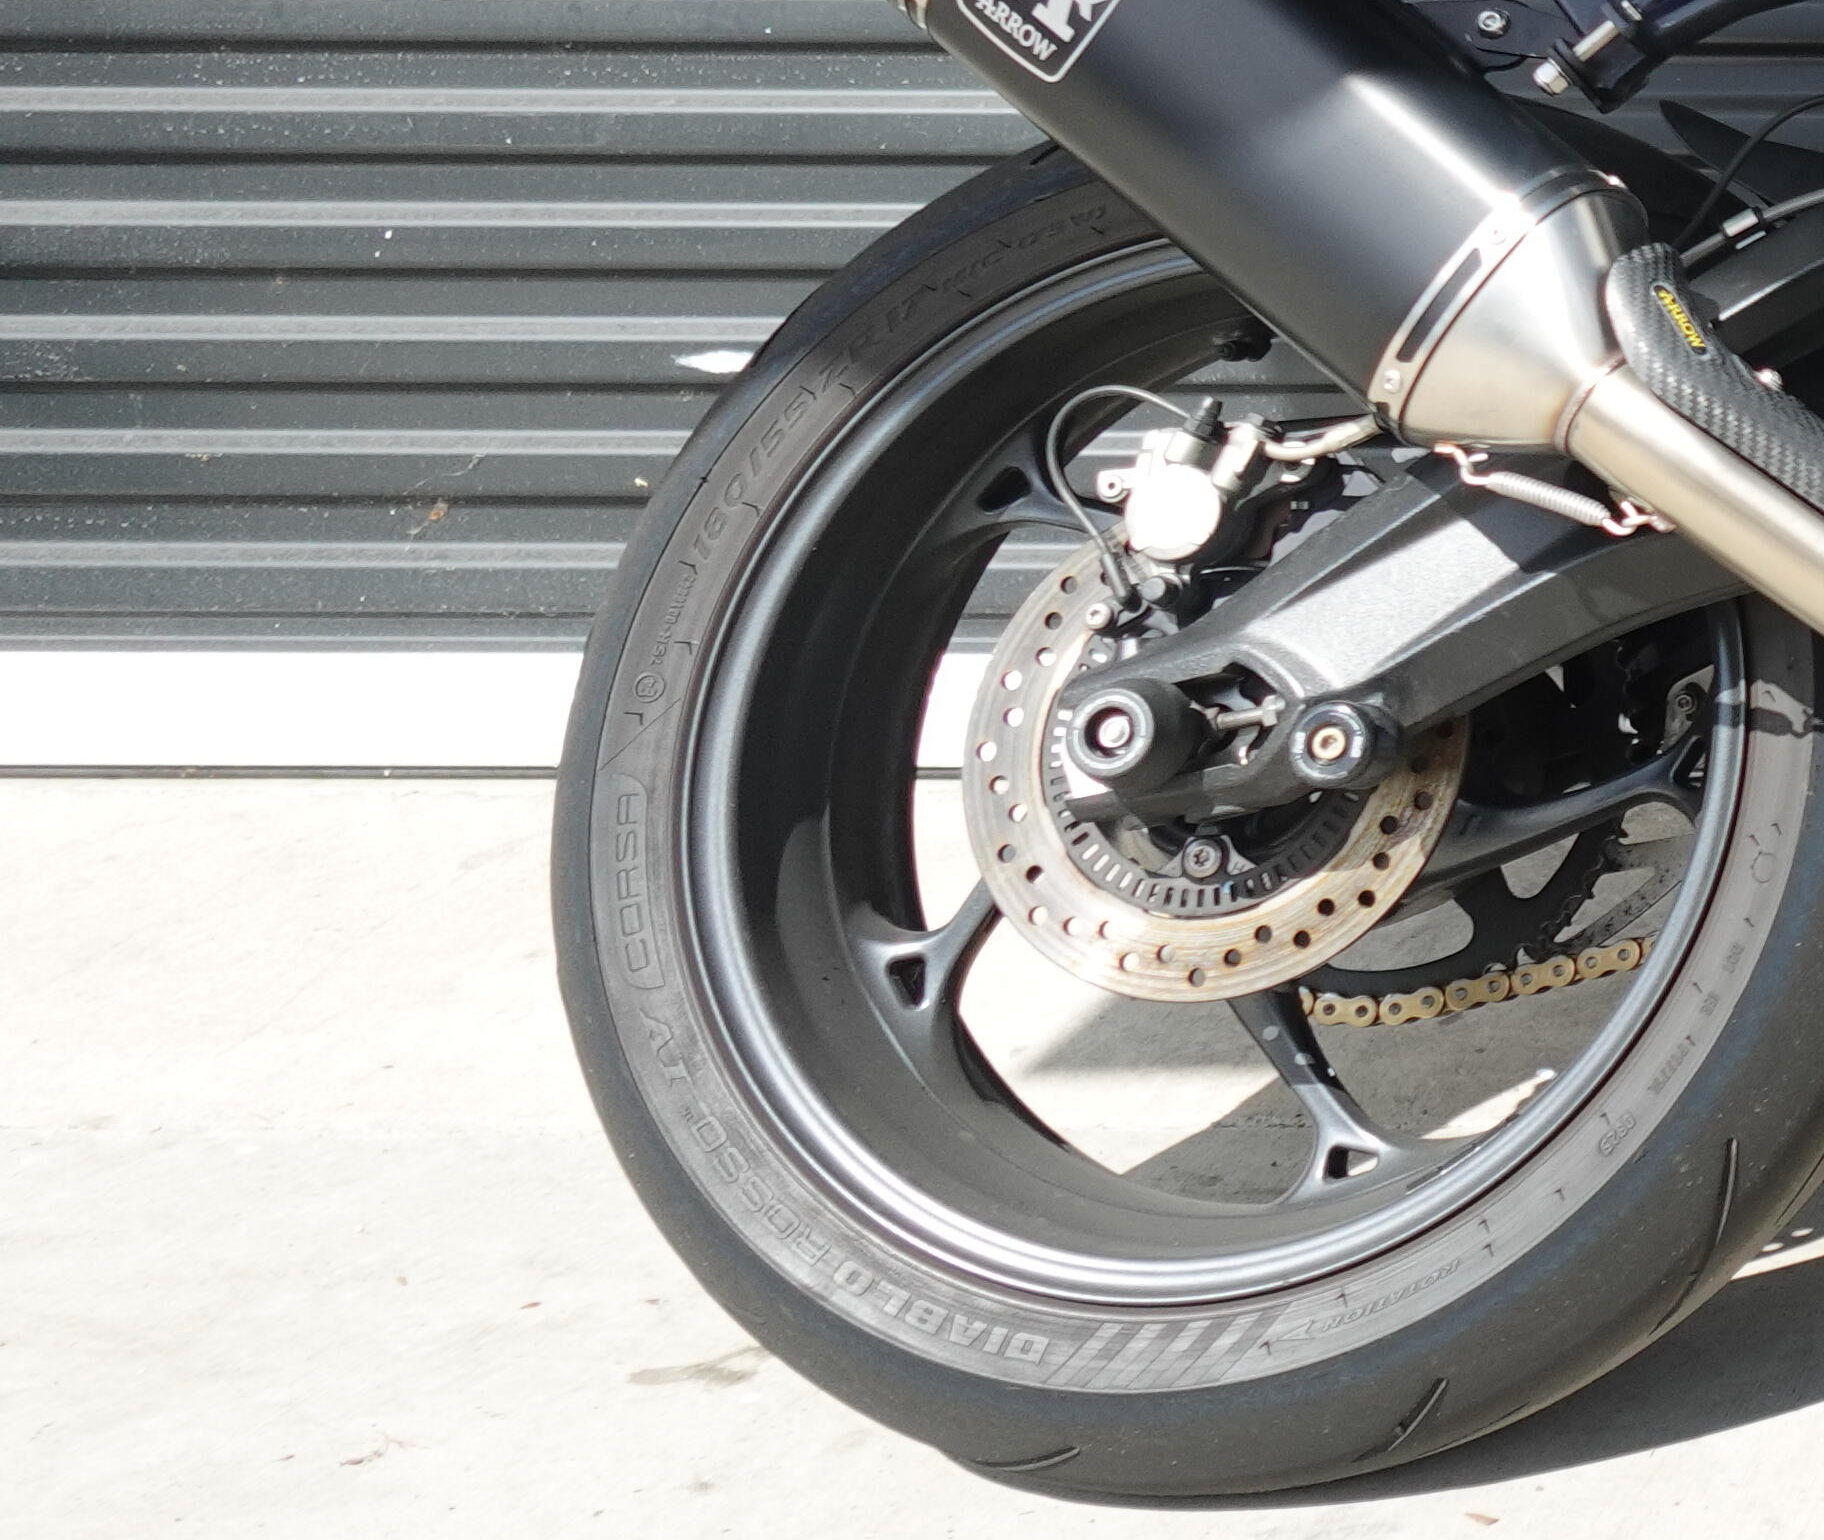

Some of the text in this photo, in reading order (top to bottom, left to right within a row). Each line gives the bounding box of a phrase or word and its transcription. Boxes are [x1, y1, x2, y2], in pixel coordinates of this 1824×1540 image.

[1657, 289, 1706, 347] ARROW
[687, 390, 818, 561] 180/55
[612, 791, 655, 974] CORSA
[686, 1111, 834, 1268] ROSSO
[831, 1253, 1050, 1368] DIABLO
